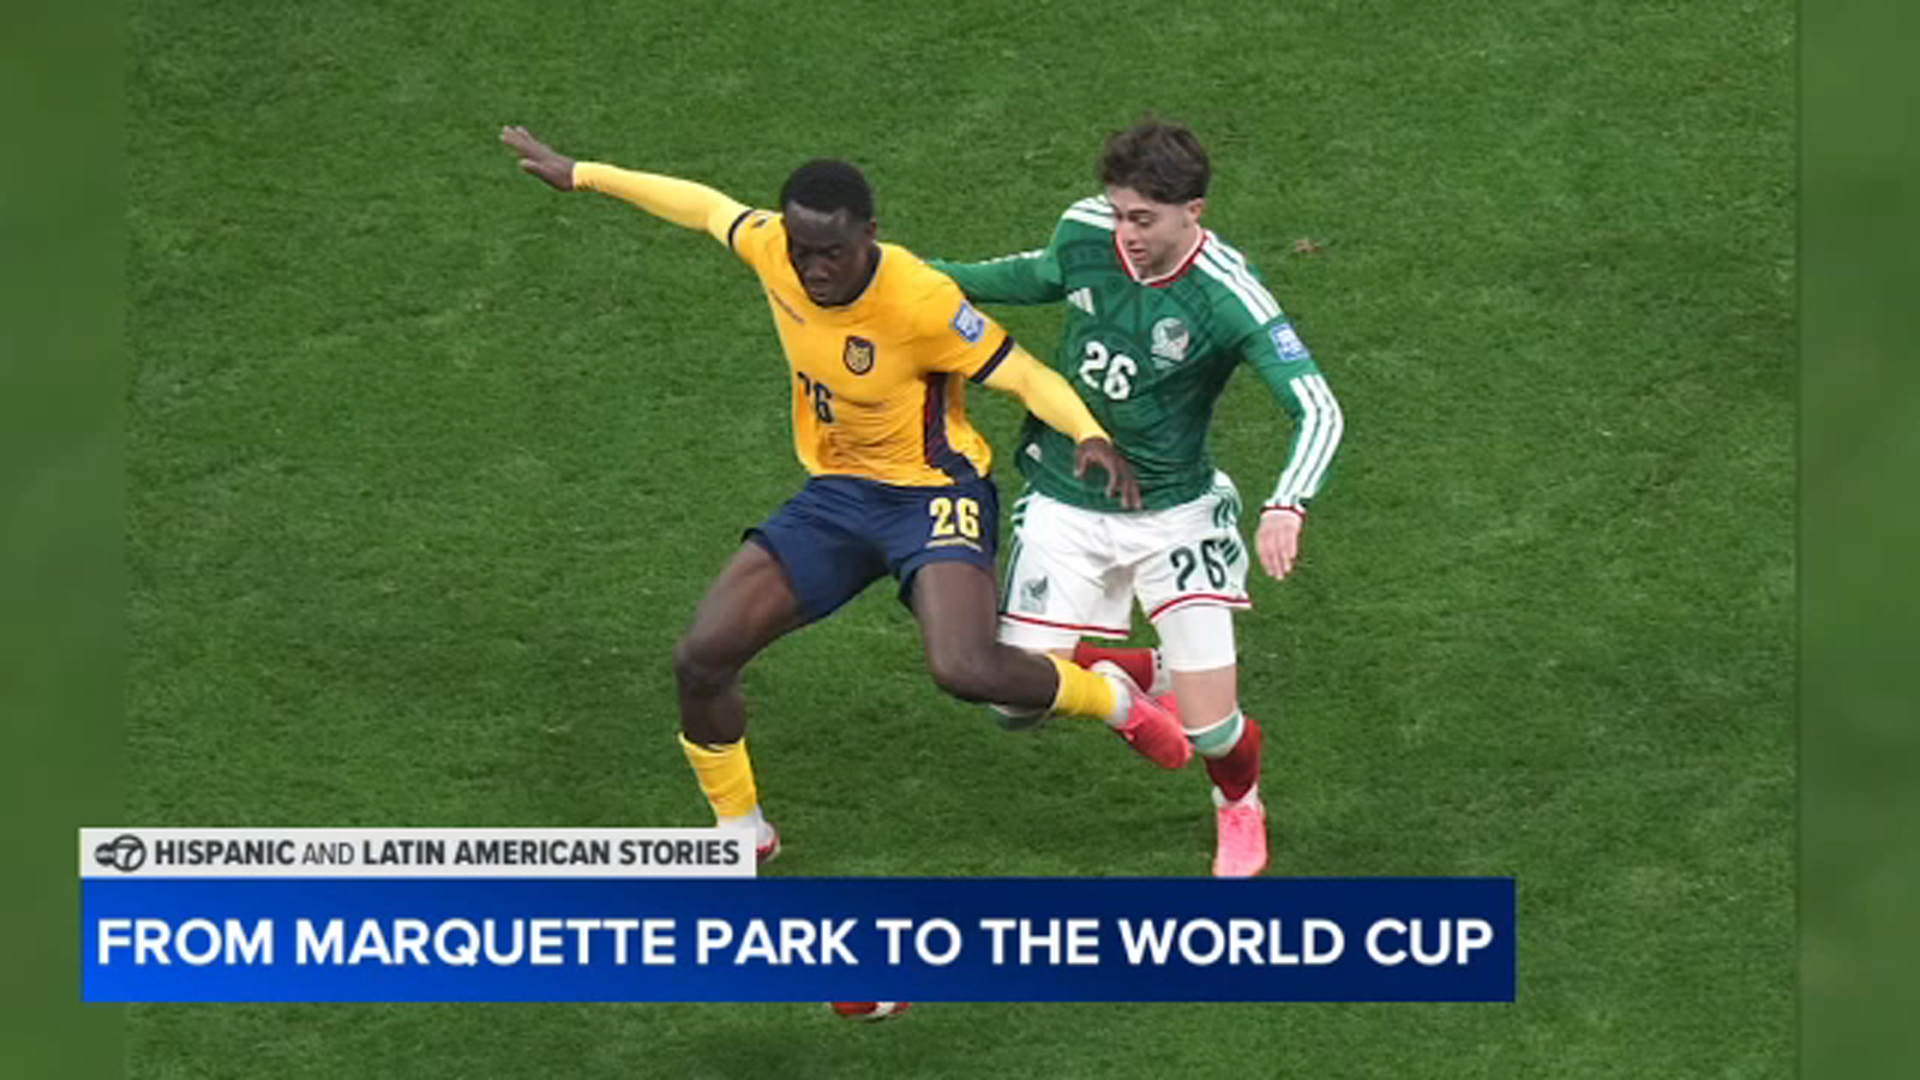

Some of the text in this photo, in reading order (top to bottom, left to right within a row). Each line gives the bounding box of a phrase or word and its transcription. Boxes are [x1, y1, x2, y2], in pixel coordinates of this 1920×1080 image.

[1079, 341, 1137, 400] 26
[930, 497, 979, 538] 26
[1169, 539, 1226, 591] 26
